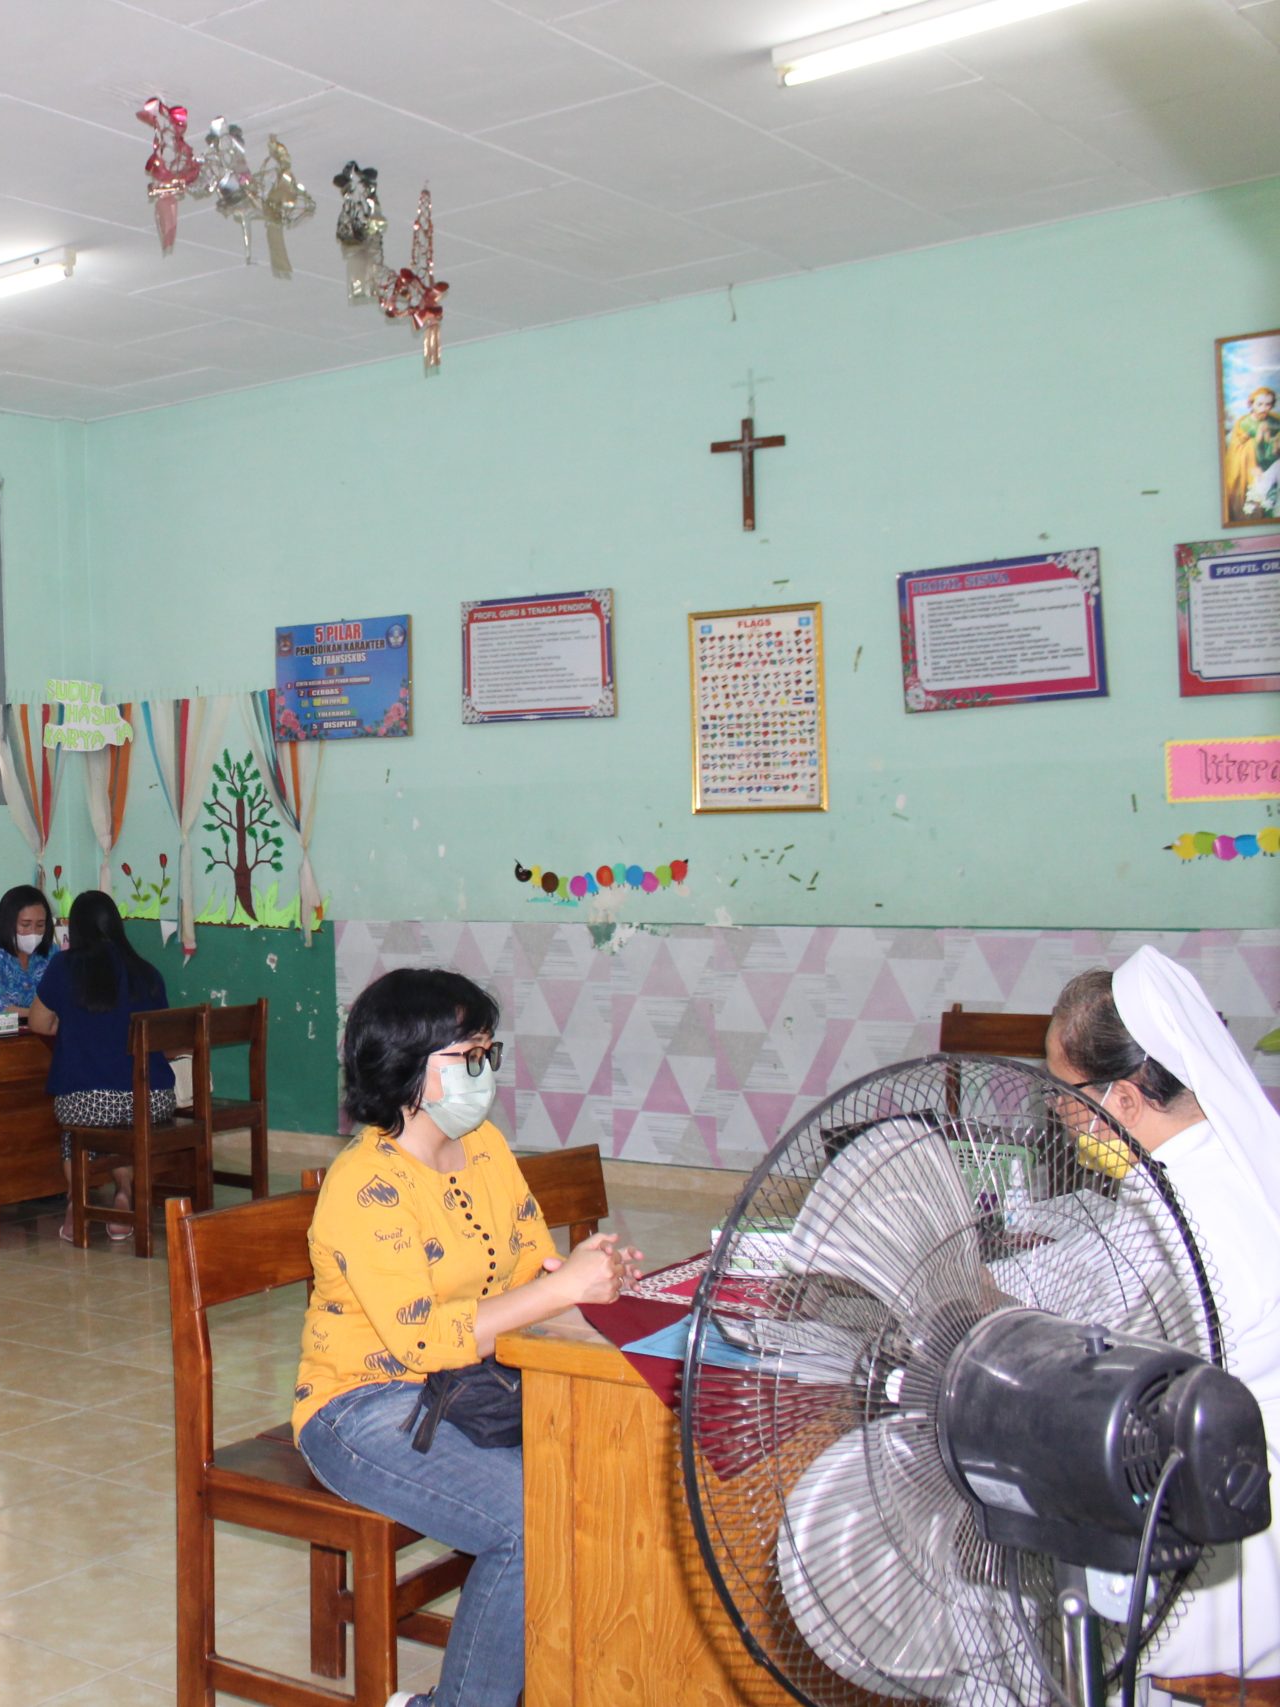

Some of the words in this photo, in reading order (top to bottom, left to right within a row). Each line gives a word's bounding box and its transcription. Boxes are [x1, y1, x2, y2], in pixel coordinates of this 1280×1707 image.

[1215, 564, 1260, 577] PROFIL
[499, 609, 520, 618] GURU
[527, 605, 557, 616] TENAGA
[737, 618, 771, 629] FLAGS
[315, 625, 323, 642] 5
[326, 623, 362, 641] PILAR
[295, 643, 342, 656] PENDIDIKAN
[344, 639, 385, 650] KARAKTER
[312, 655, 322, 666] SD
[322, 652, 366, 664] FRANSISKUS
[47, 679, 102, 704] SUDUT
[65, 703, 120, 726] HASIL
[323, 719, 357, 729] DISIPLIN
[45, 724, 105, 750] KARYA
